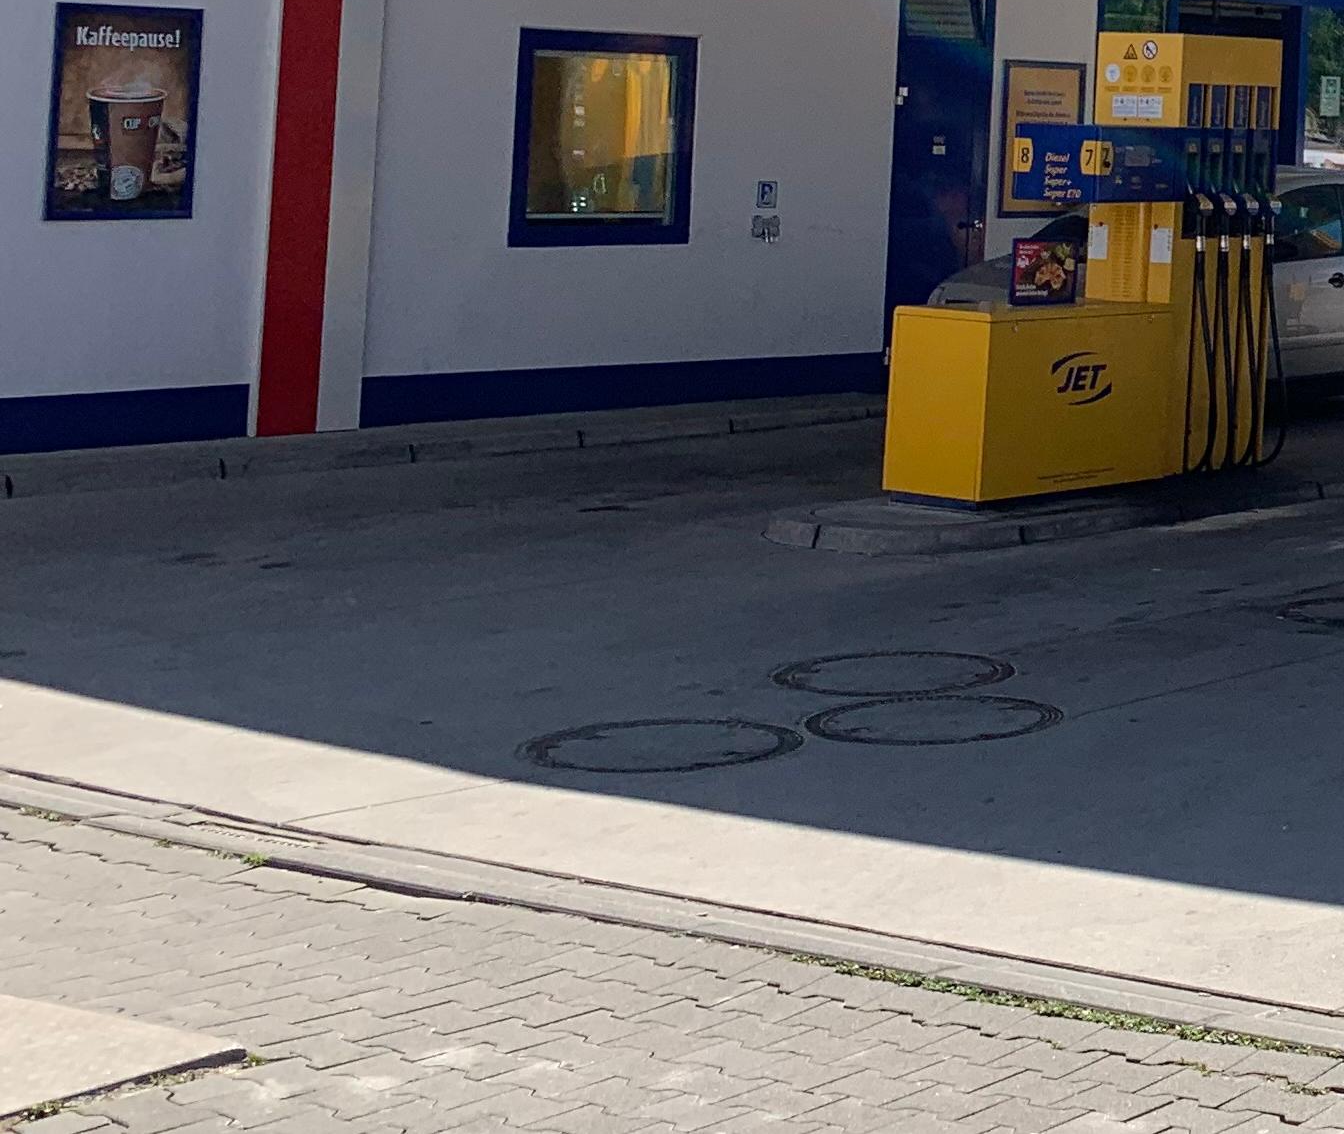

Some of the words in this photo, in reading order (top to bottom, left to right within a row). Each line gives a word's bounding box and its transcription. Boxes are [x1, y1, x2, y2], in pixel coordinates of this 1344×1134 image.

[76, 25, 181, 52] Kaffeepause!
[1020, 147, 1030, 164] 8
[1045, 152, 1070, 163] Diesel
[1085, 149, 1093, 166] 7
[1057, 364, 1107, 394] JET
